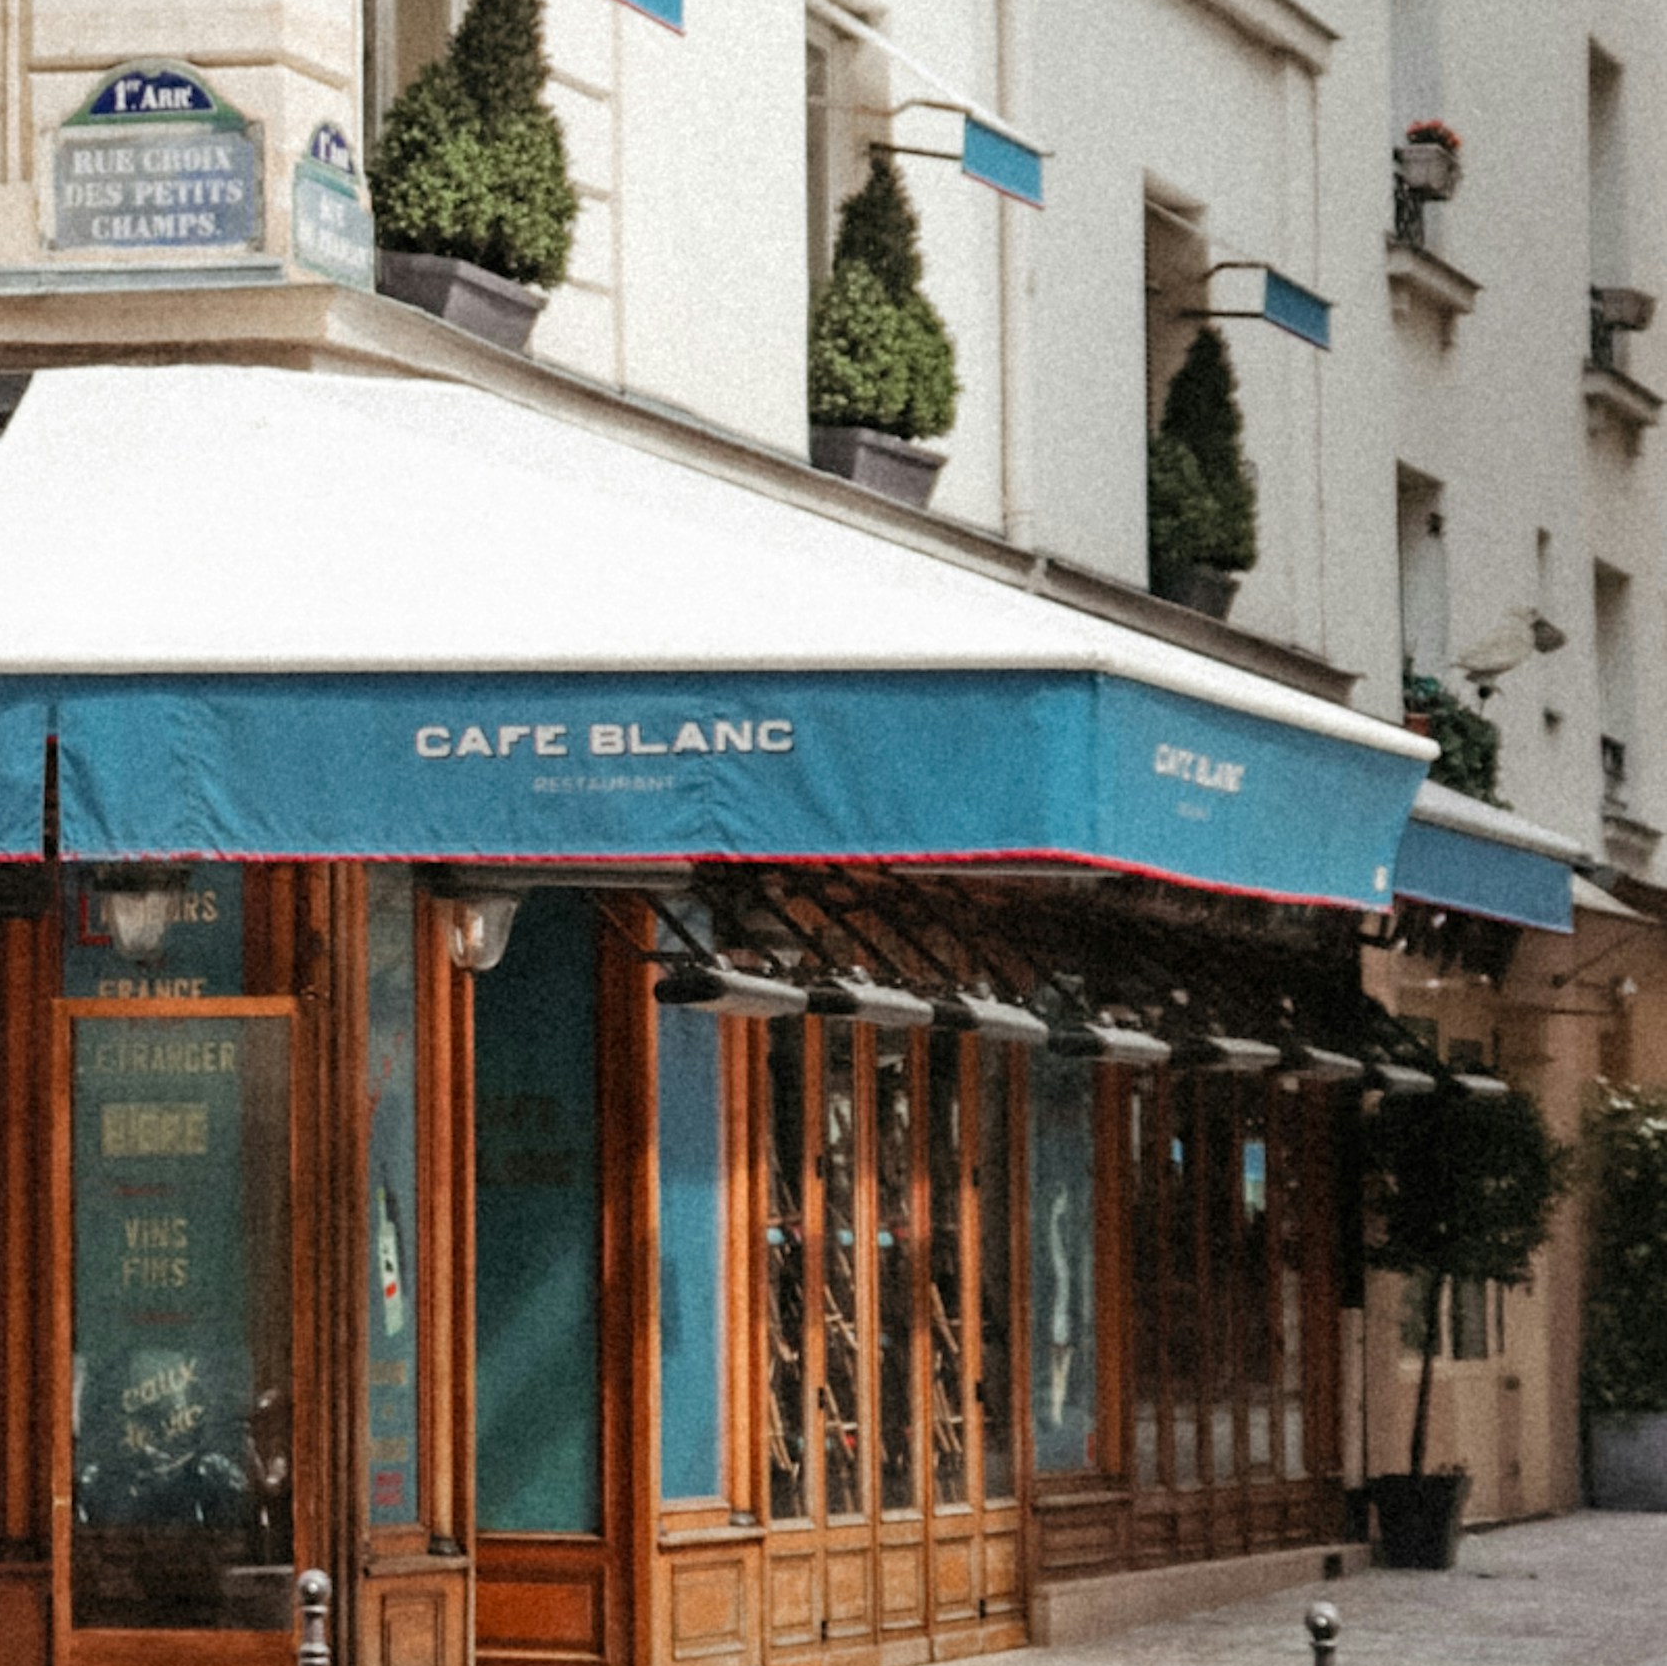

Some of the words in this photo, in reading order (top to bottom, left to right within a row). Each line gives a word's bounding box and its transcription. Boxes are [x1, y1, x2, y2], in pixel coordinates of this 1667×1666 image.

[73, 148, 135, 175] RUE
[142, 145, 233, 173] CROIX
[64, 182, 124, 209] DES
[134, 180, 244, 207] PETITS
[415, 724, 569, 758] CAFE
[589, 718, 794, 756] BLANC
[124, 1216, 189, 1249] VINS
[121, 1256, 190, 1287] FINS
